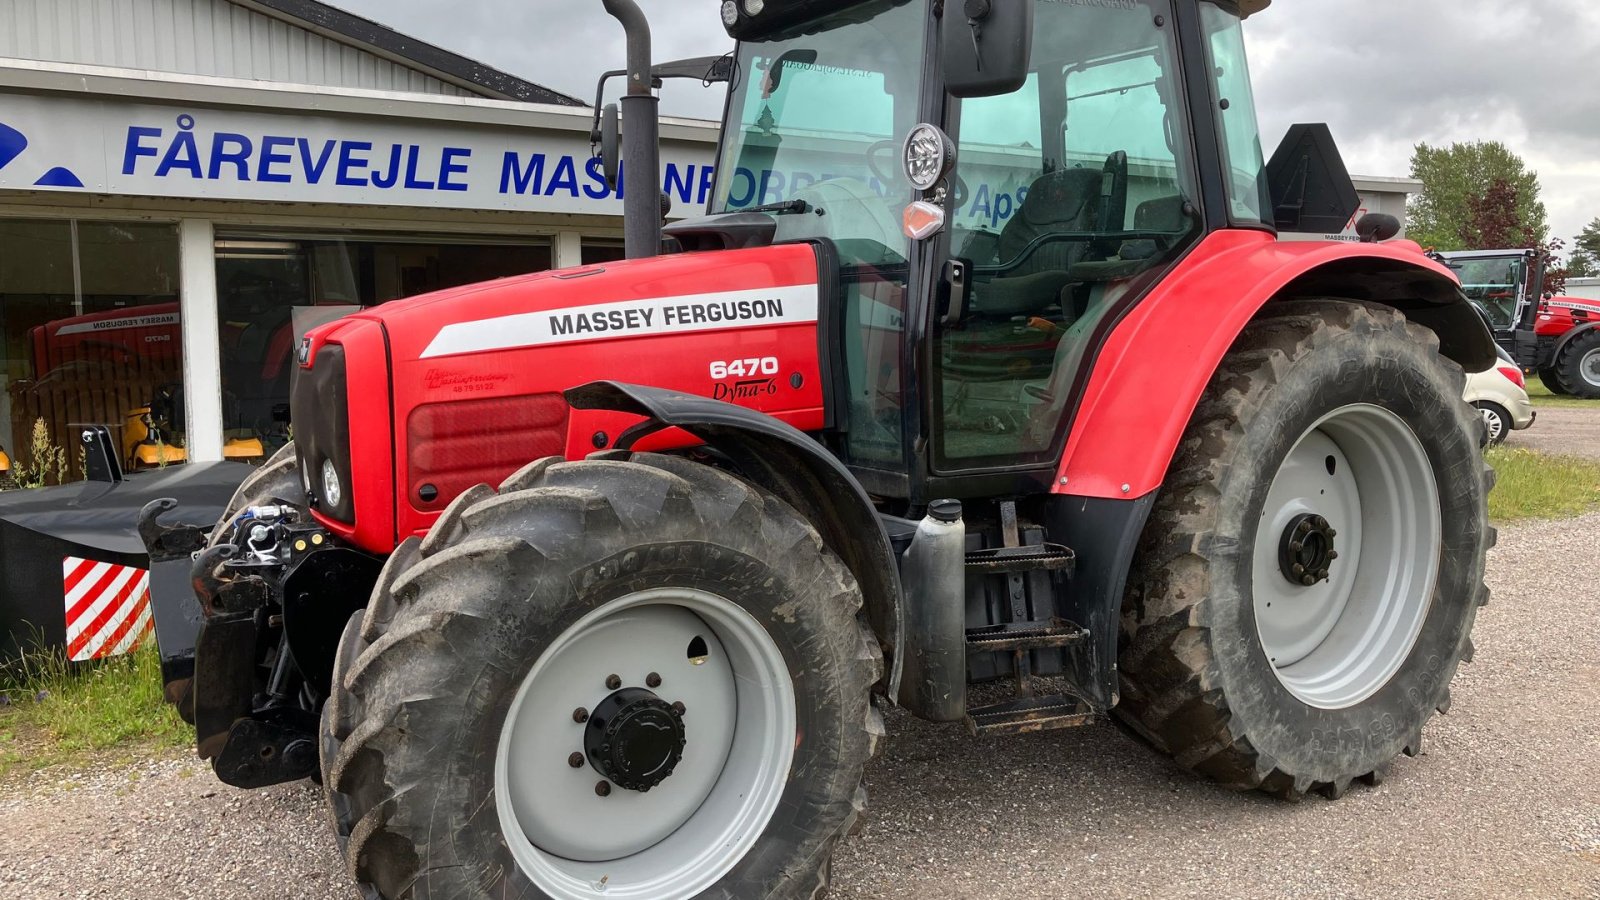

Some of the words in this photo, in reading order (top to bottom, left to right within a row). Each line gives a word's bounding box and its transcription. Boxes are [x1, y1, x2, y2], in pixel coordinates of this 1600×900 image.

[122, 113, 472, 192] FÅREVEJLE
[549, 308, 654, 335] MASSEY
[663, 299, 784, 326] FERGUSON
[1575, 304, 1600, 312] FERGUSO
[709, 356, 779, 380] 6470
[712, 377, 777, 404] Dyna-6
